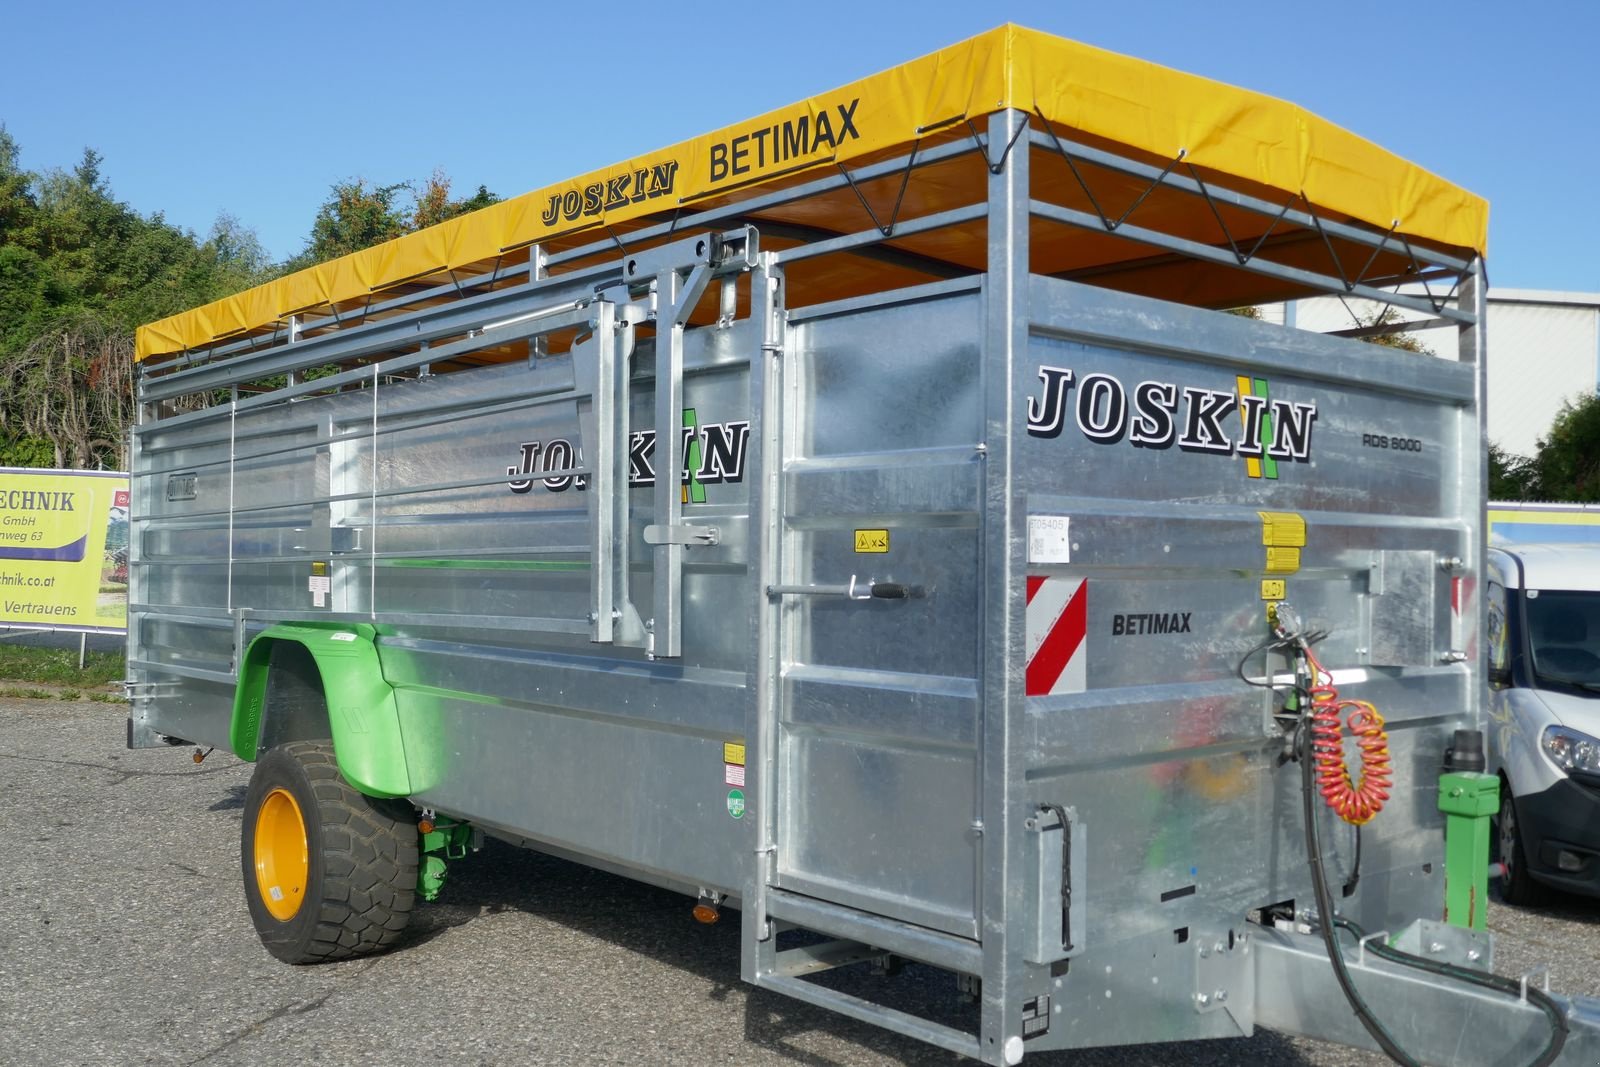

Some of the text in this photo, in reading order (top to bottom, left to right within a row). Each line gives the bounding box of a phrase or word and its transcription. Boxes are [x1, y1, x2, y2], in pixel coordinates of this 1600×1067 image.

[541, 98, 860, 227] JOSKIN BETIMAX
[1027, 365, 1318, 463] JOSKIN
[1391, 437, 1422, 452] 6000
[3, 515, 36, 526] GmbH
[31, 532, 43, 541] 63
[0, 572, 55, 587] hnik.co.at
[4, 600, 77, 616] Vertrauens
[1112, 612, 1192, 636] BETIMAX
